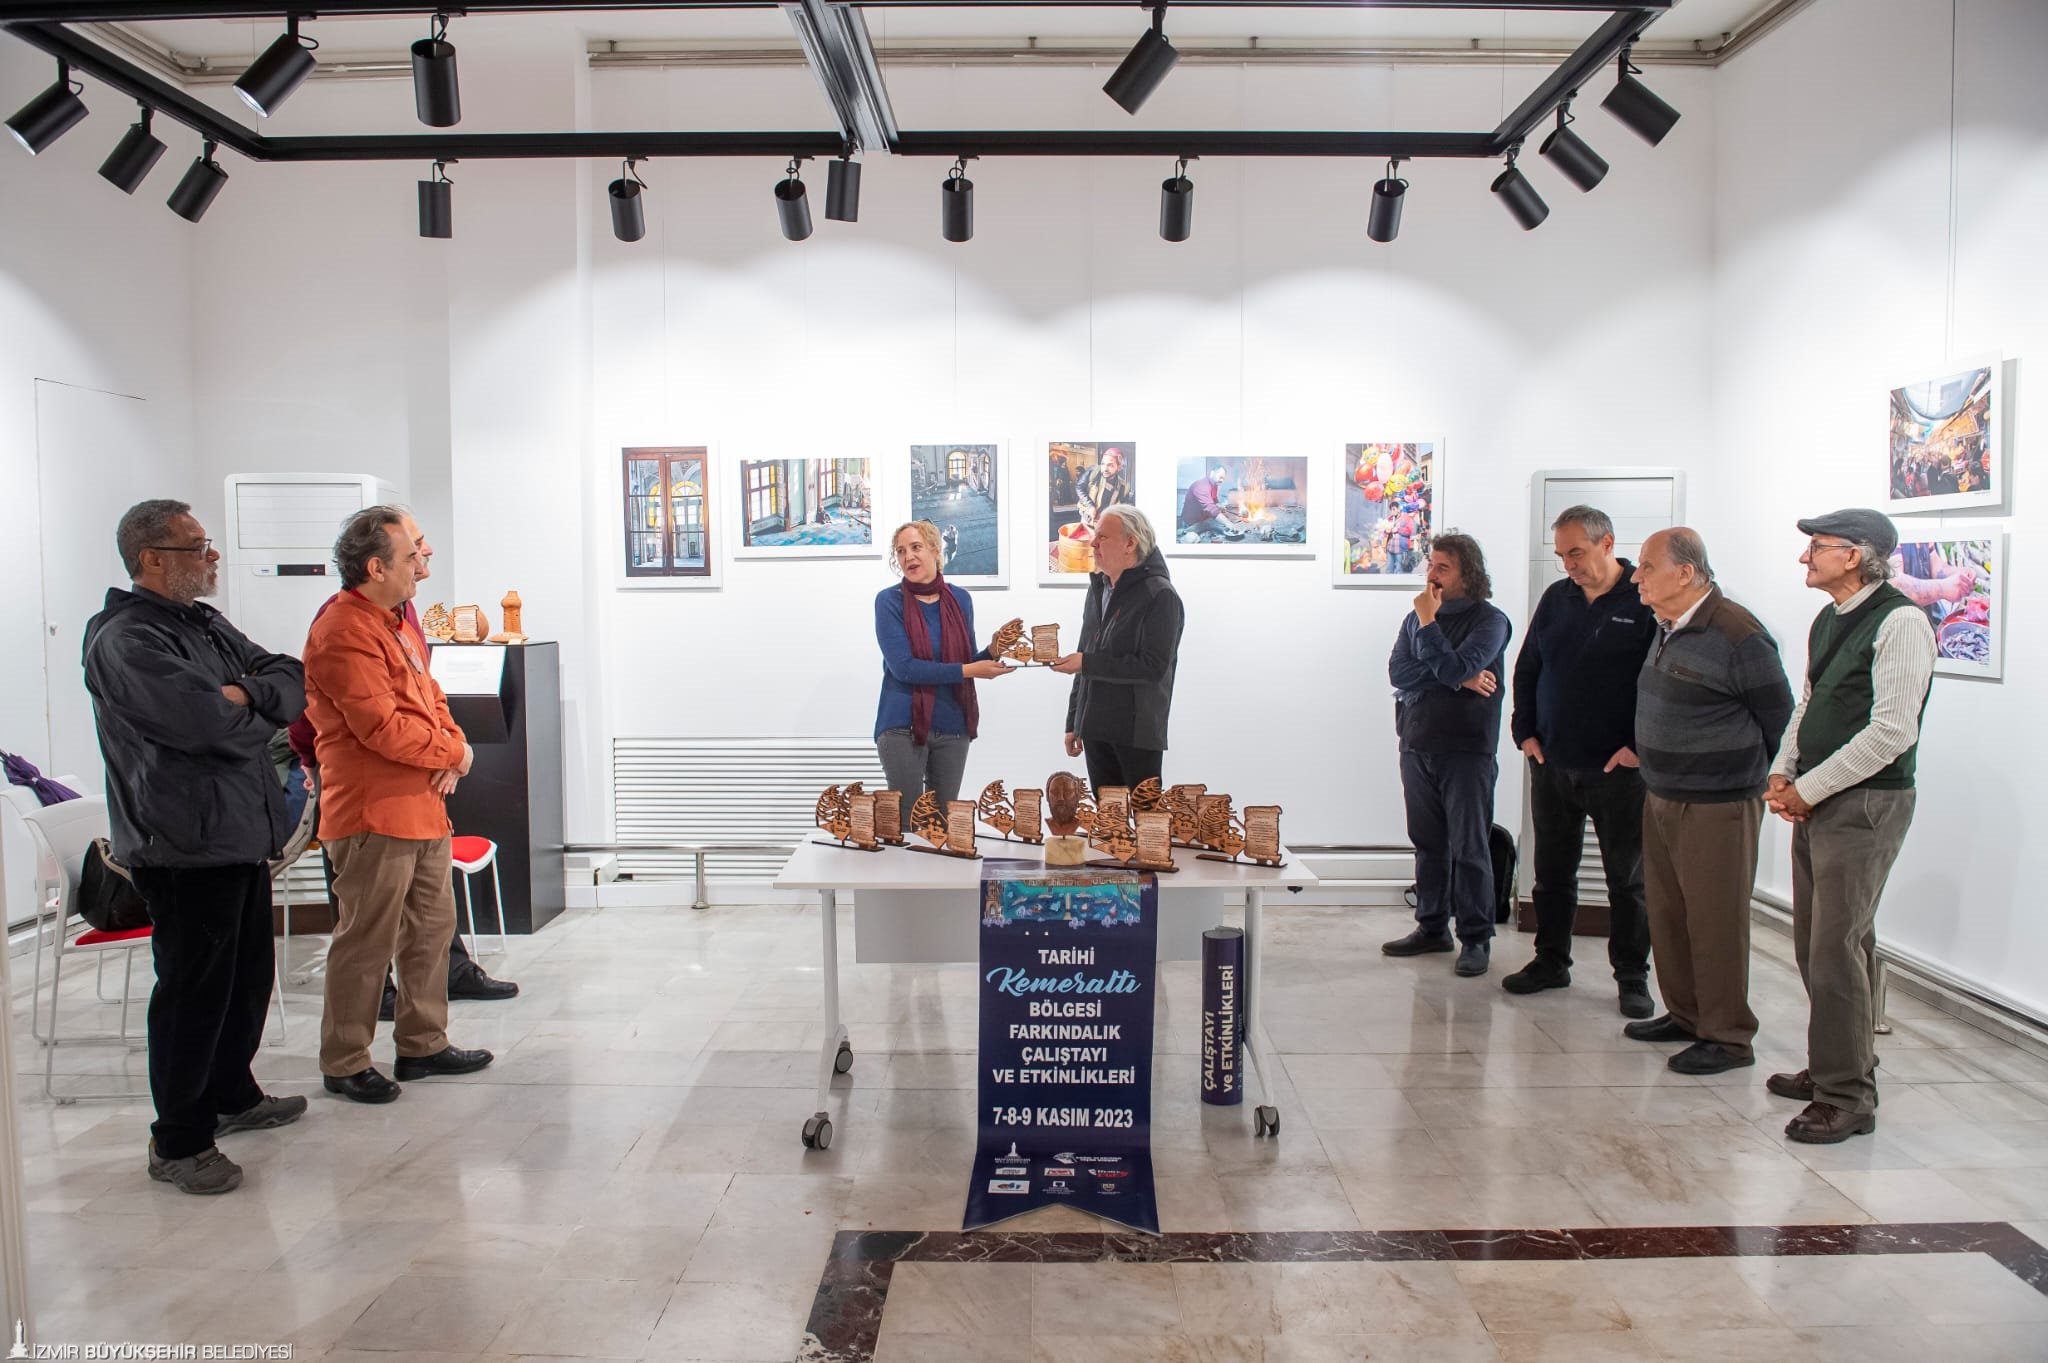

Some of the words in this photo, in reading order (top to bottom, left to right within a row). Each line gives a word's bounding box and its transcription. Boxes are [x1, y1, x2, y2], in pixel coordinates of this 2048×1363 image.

[1038, 946, 1095, 965] TARİHİ
[986, 966, 1142, 998] Kemeraltı
[1029, 999, 1102, 1018] BÖLGESİ
[1218, 964, 1234, 1070] ETKİNLİKLERİ
[1009, 1024, 1121, 1040] FARKINDALIK
[1021, 1046, 1107, 1067] ÇALIŞTAYI
[1204, 1011, 1218, 1091] ÇALIŞTAYI
[992, 1069, 1015, 1084] VE
[1019, 1065, 1135, 1085] ETKİNLİKLERİ
[1223, 1073, 1234, 1093] ve
[992, 1106, 1032, 1126] 7-8-9
[1036, 1107, 1090, 1128] KASIM
[1094, 1108, 1133, 1129] 2023
